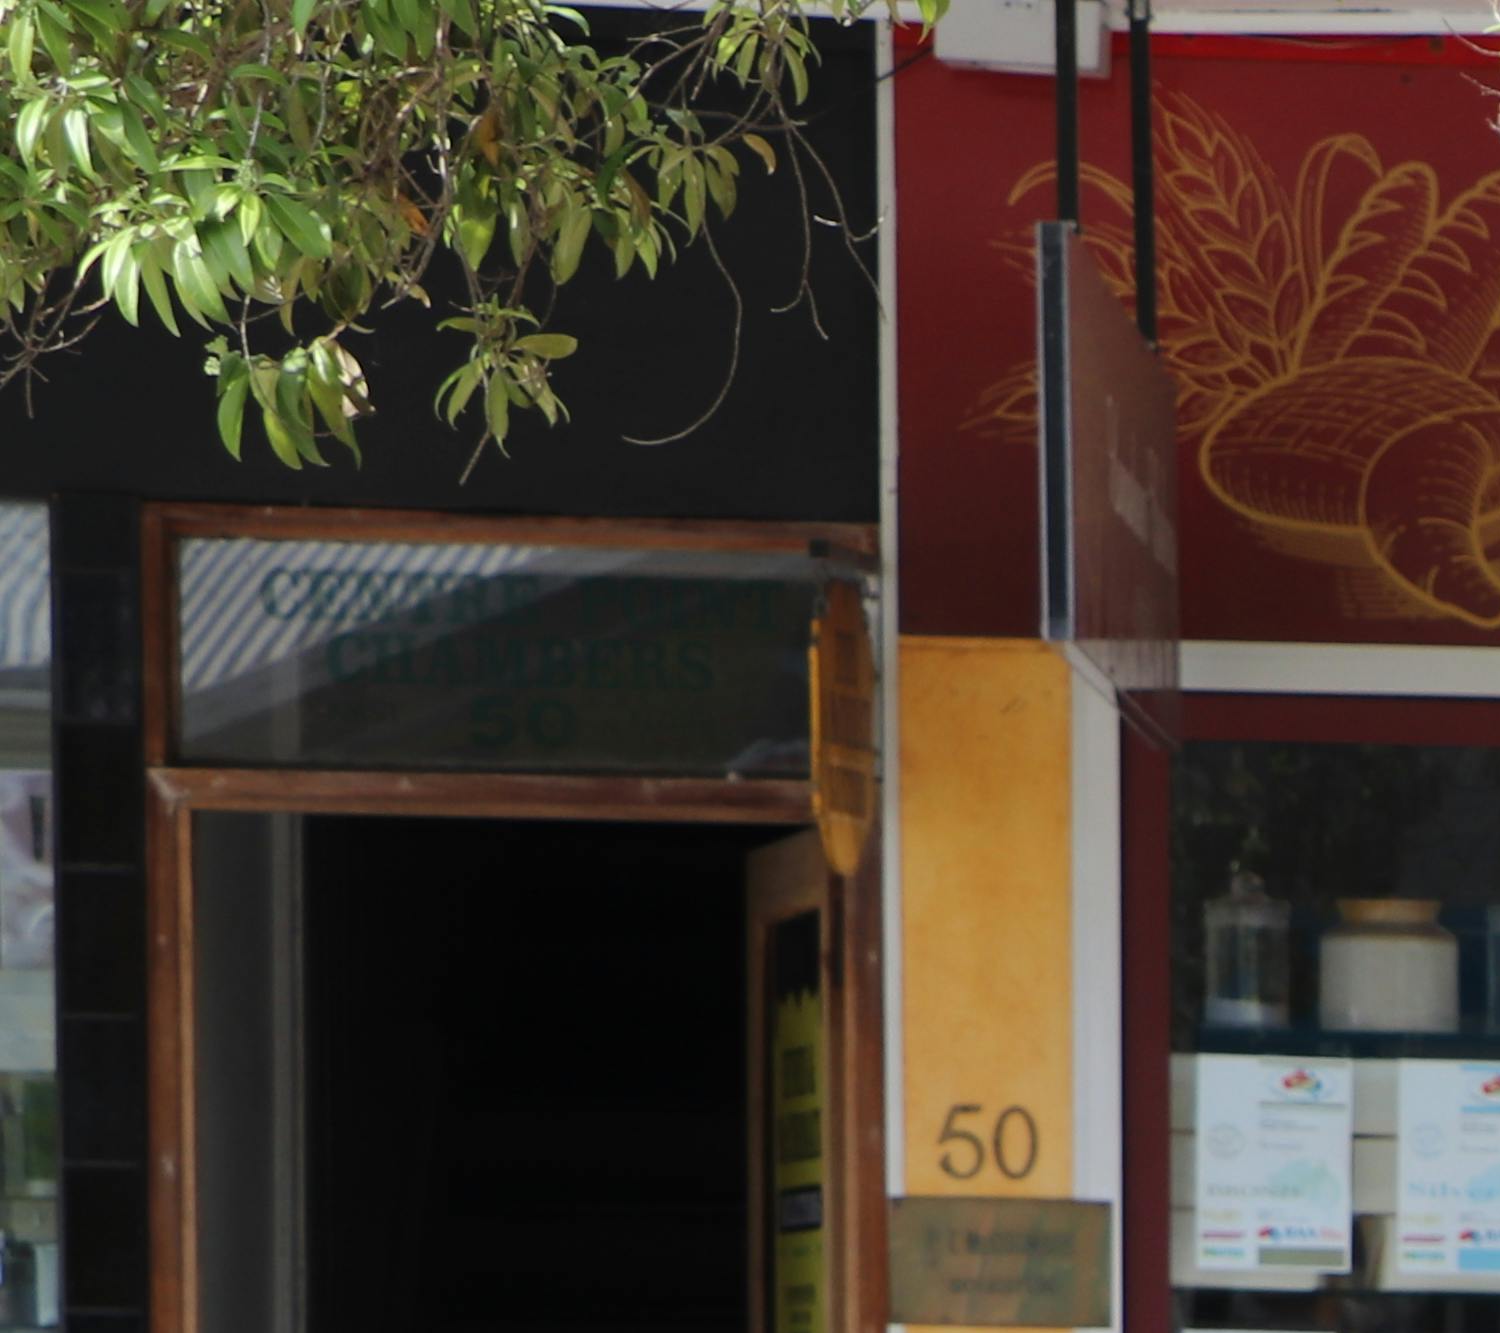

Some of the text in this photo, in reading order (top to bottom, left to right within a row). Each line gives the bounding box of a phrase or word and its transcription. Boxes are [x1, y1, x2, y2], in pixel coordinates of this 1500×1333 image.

[260, 566, 785, 634] CENTRE POINT
[326, 633, 717, 692] CHAMBERS
[469, 698, 582, 747] 50
[936, 1104, 1040, 1181] 50
